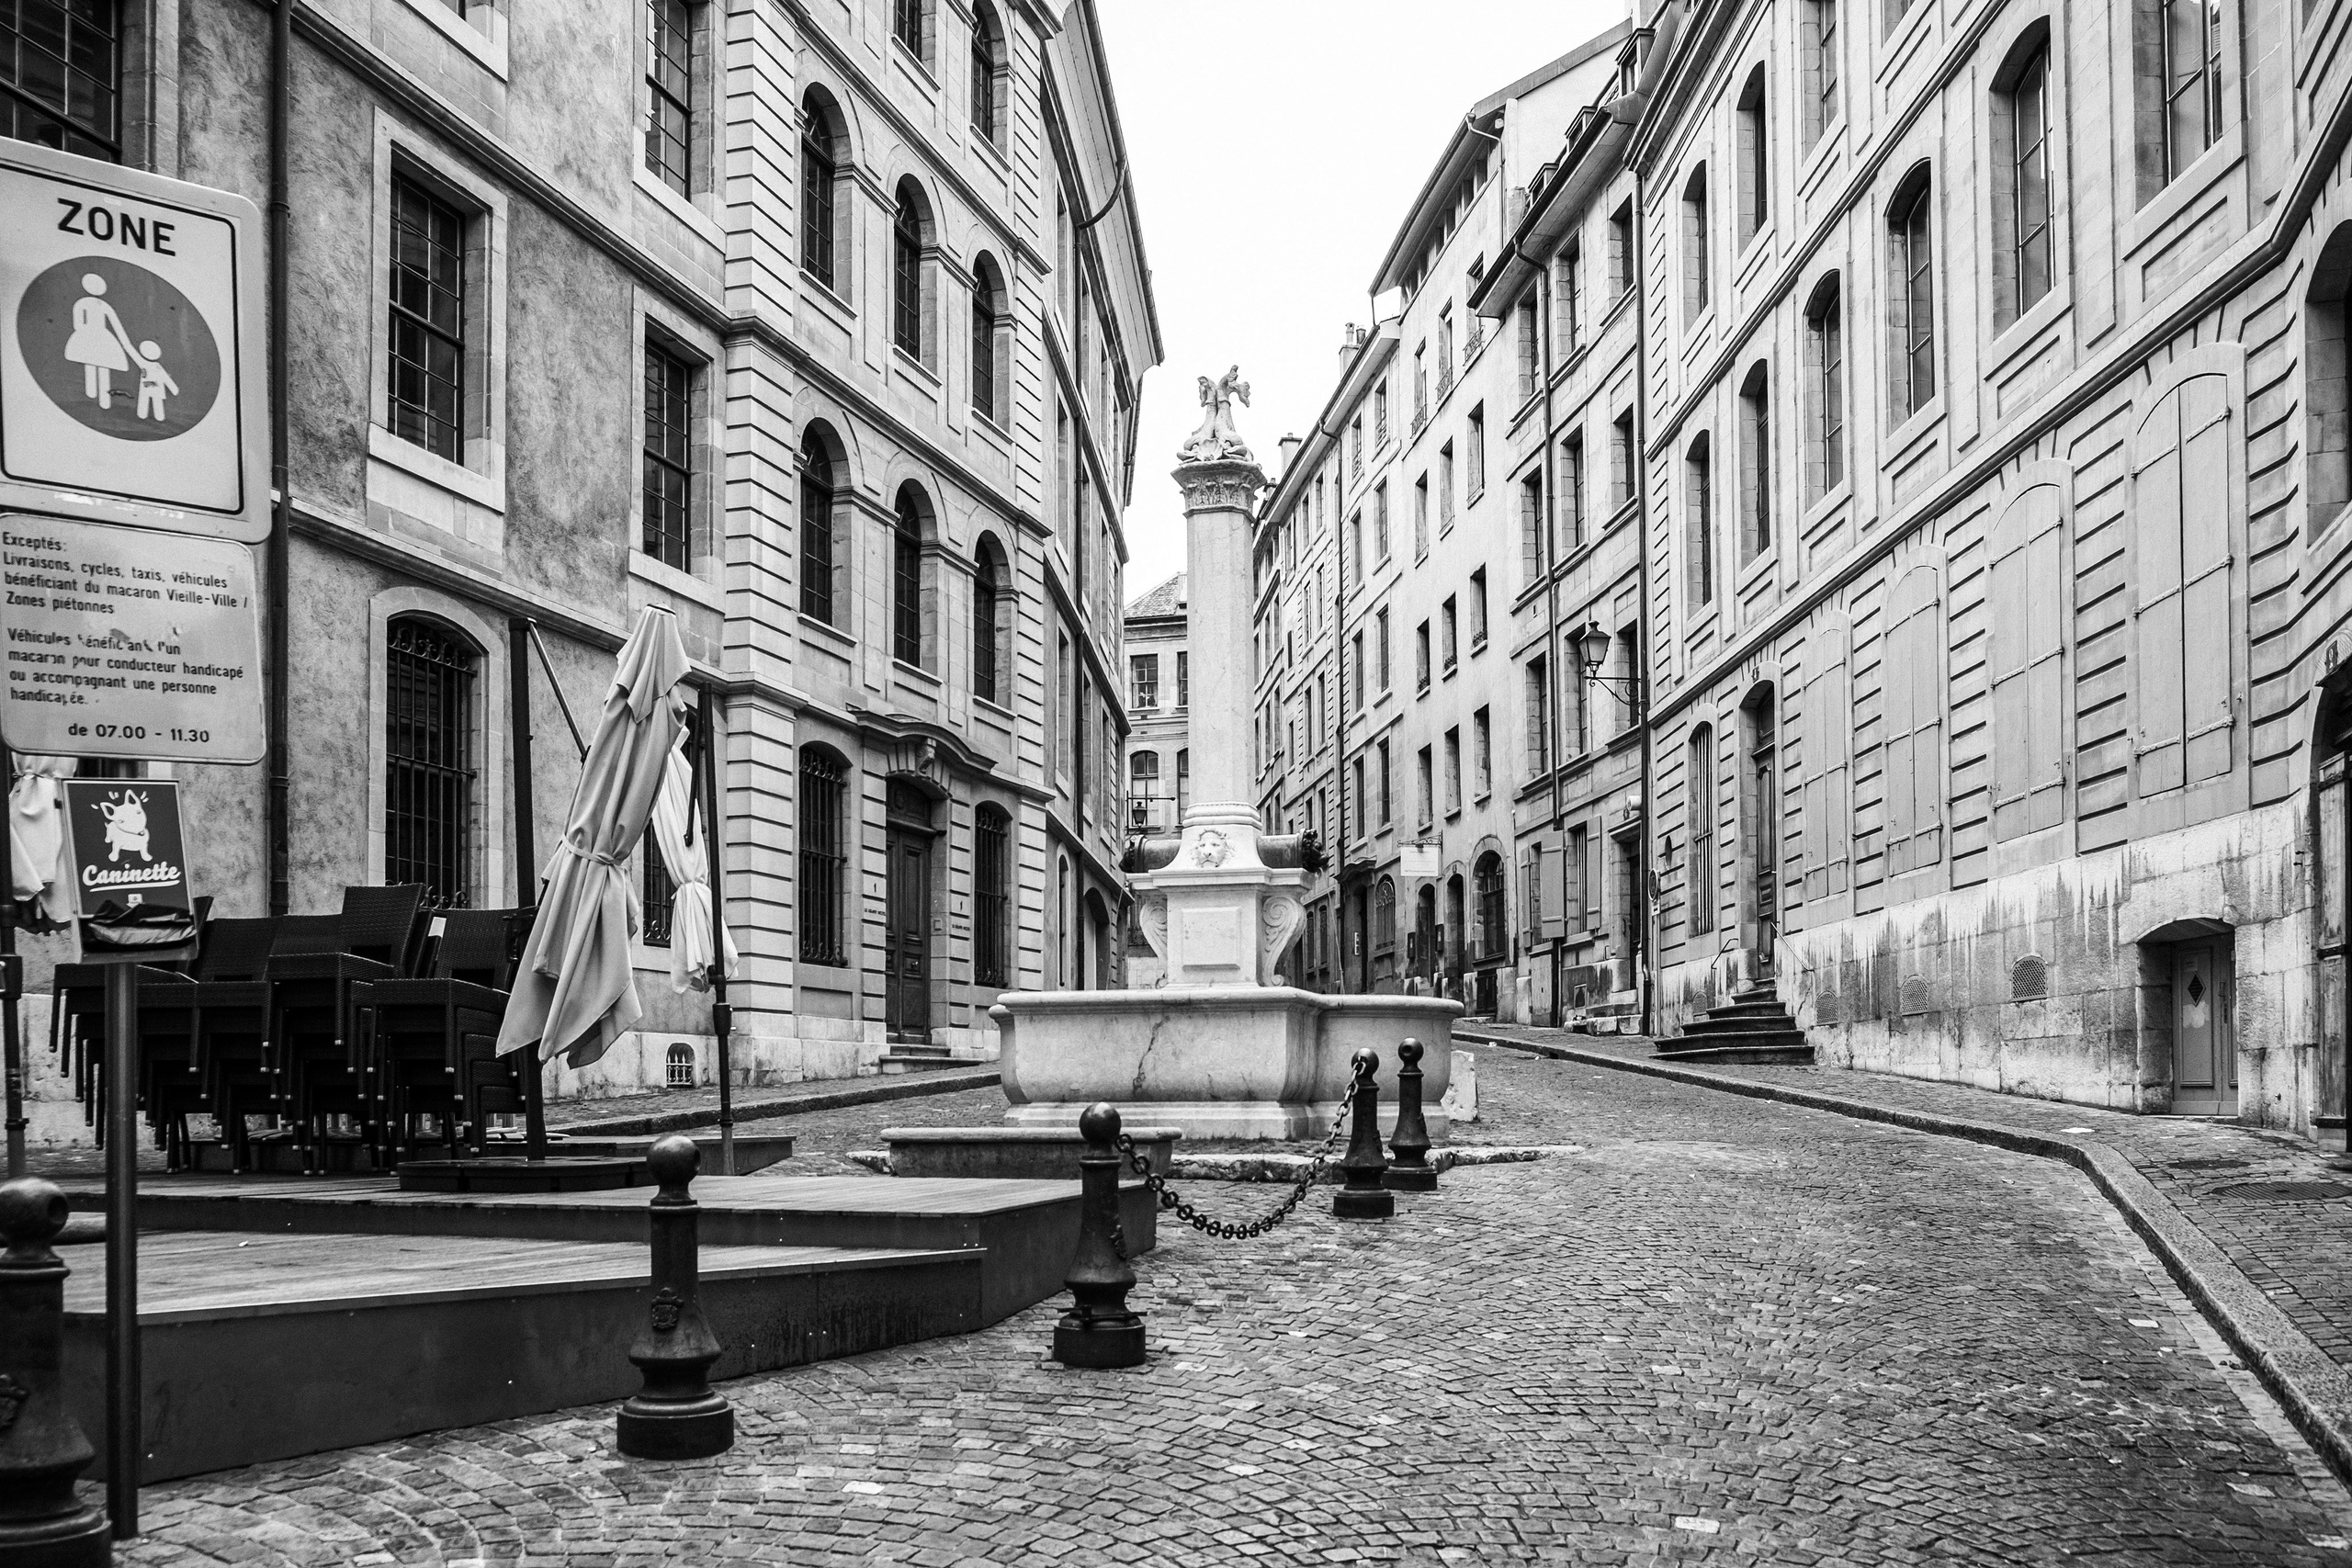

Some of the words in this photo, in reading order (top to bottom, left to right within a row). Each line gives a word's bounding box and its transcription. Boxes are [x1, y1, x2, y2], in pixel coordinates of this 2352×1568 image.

[57, 197, 175, 257] ZONE
[2, 531, 67, 552] Exceptés:
[3, 551, 74, 572] Livraisons,
[81, 562, 124, 578] cycles,
[131, 567, 165, 582] taxis,
[172, 571, 227, 588] véhicules
[5, 571, 77, 592] bénéficiant
[85, 580, 100, 594] du
[107, 585, 160, 599] macaron
[166, 589, 237, 607] Vieille-Ville
[6, 591, 46, 607] Zones
[52, 596, 114, 614] piétonnes
[7, 627, 71, 645] Véhicules
[77, 634, 153, 652] énéfican
[107, 659, 176, 673] conducteur
[183, 662, 243, 680] handicapé
[9, 670, 27, 682] ou
[32, 672, 127, 690] accompagnant
[133, 680, 155, 690] une
[162, 682, 217, 694] personne
[68, 723, 88, 736] de
[95, 724, 146, 739] 07.00
[170, 728, 209, 742] 11.30
[82, 861, 182, 886] Caninette
